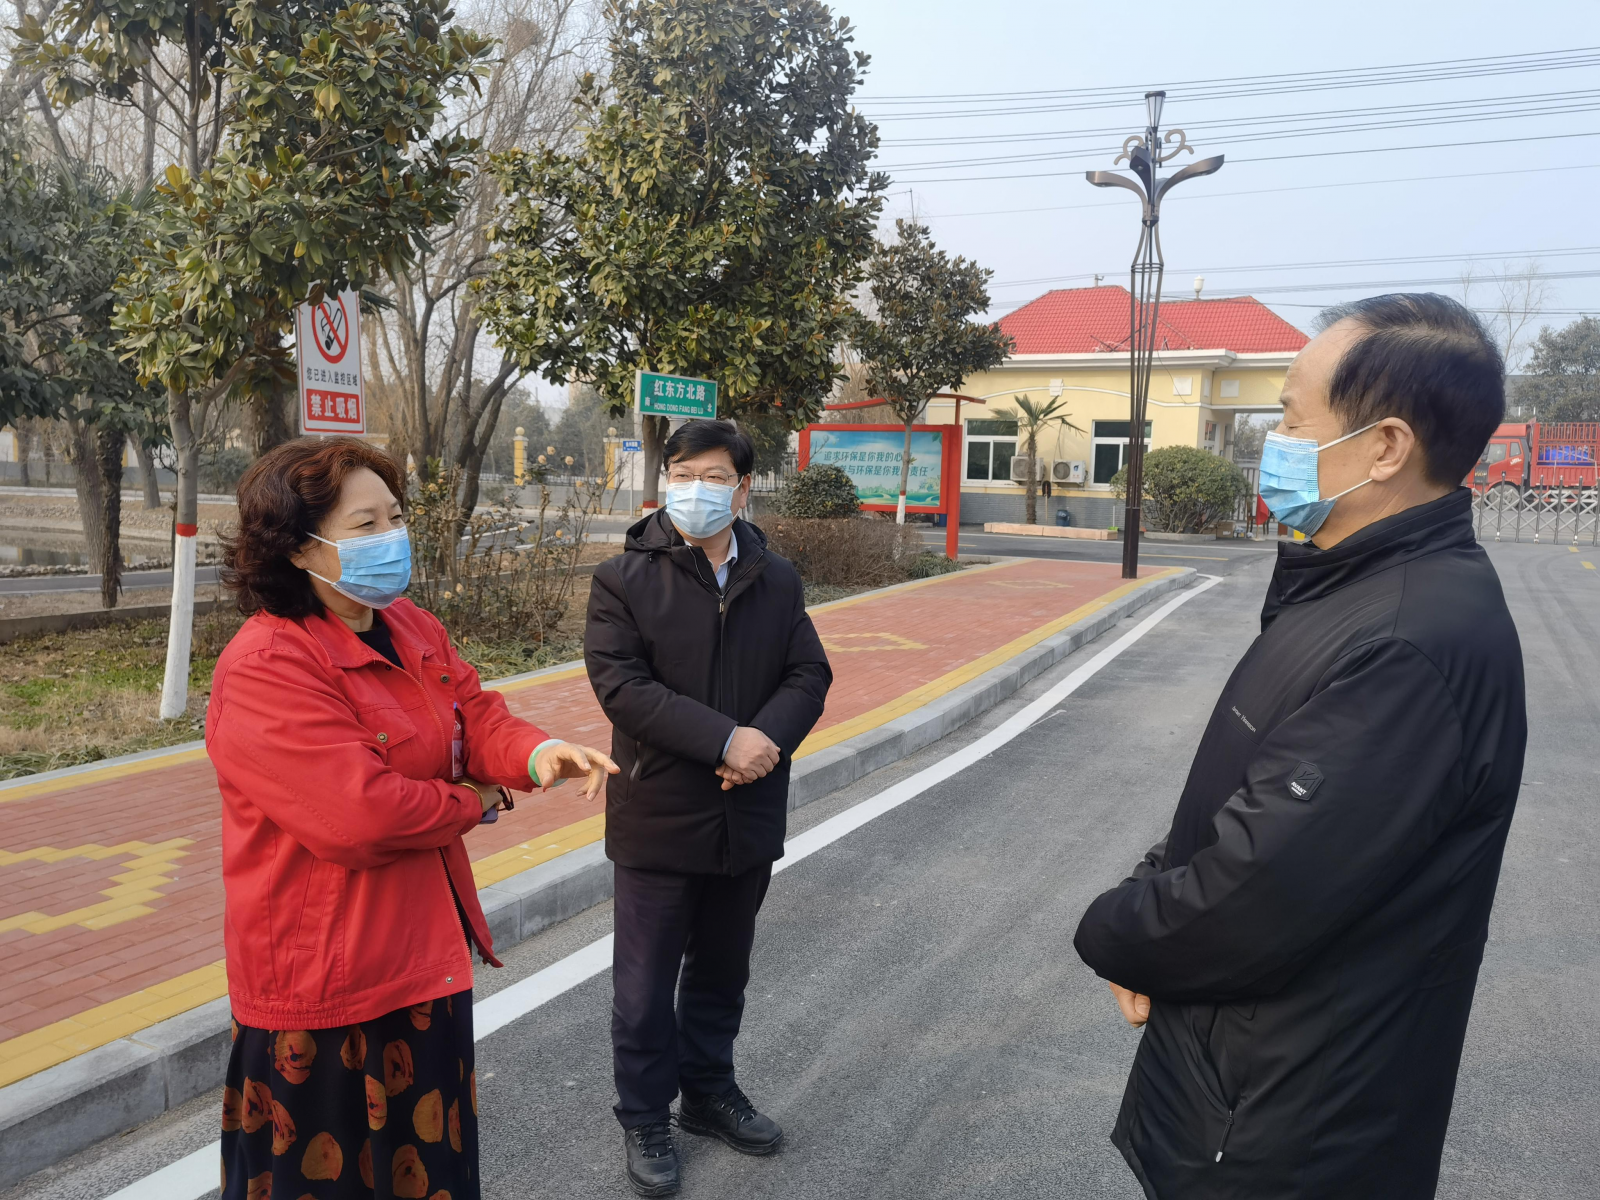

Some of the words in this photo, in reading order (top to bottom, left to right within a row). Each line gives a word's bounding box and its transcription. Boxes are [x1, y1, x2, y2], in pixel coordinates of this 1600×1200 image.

[306, 367, 358, 386] 您已进入监控区域
[654, 379, 705, 401] 红东方北路
[310, 393, 358, 420] 禁止吸烟
[645, 397, 651, 406] 南
[707, 403, 712, 412] 北
[667, 404, 678, 412] DONG
[679, 405, 690, 413] FANG
[823, 451, 912, 463] 追求环保是你我的心
[840, 464, 928, 477] 与环保是你我责任
[1291, 781, 1307, 795] AVANT
